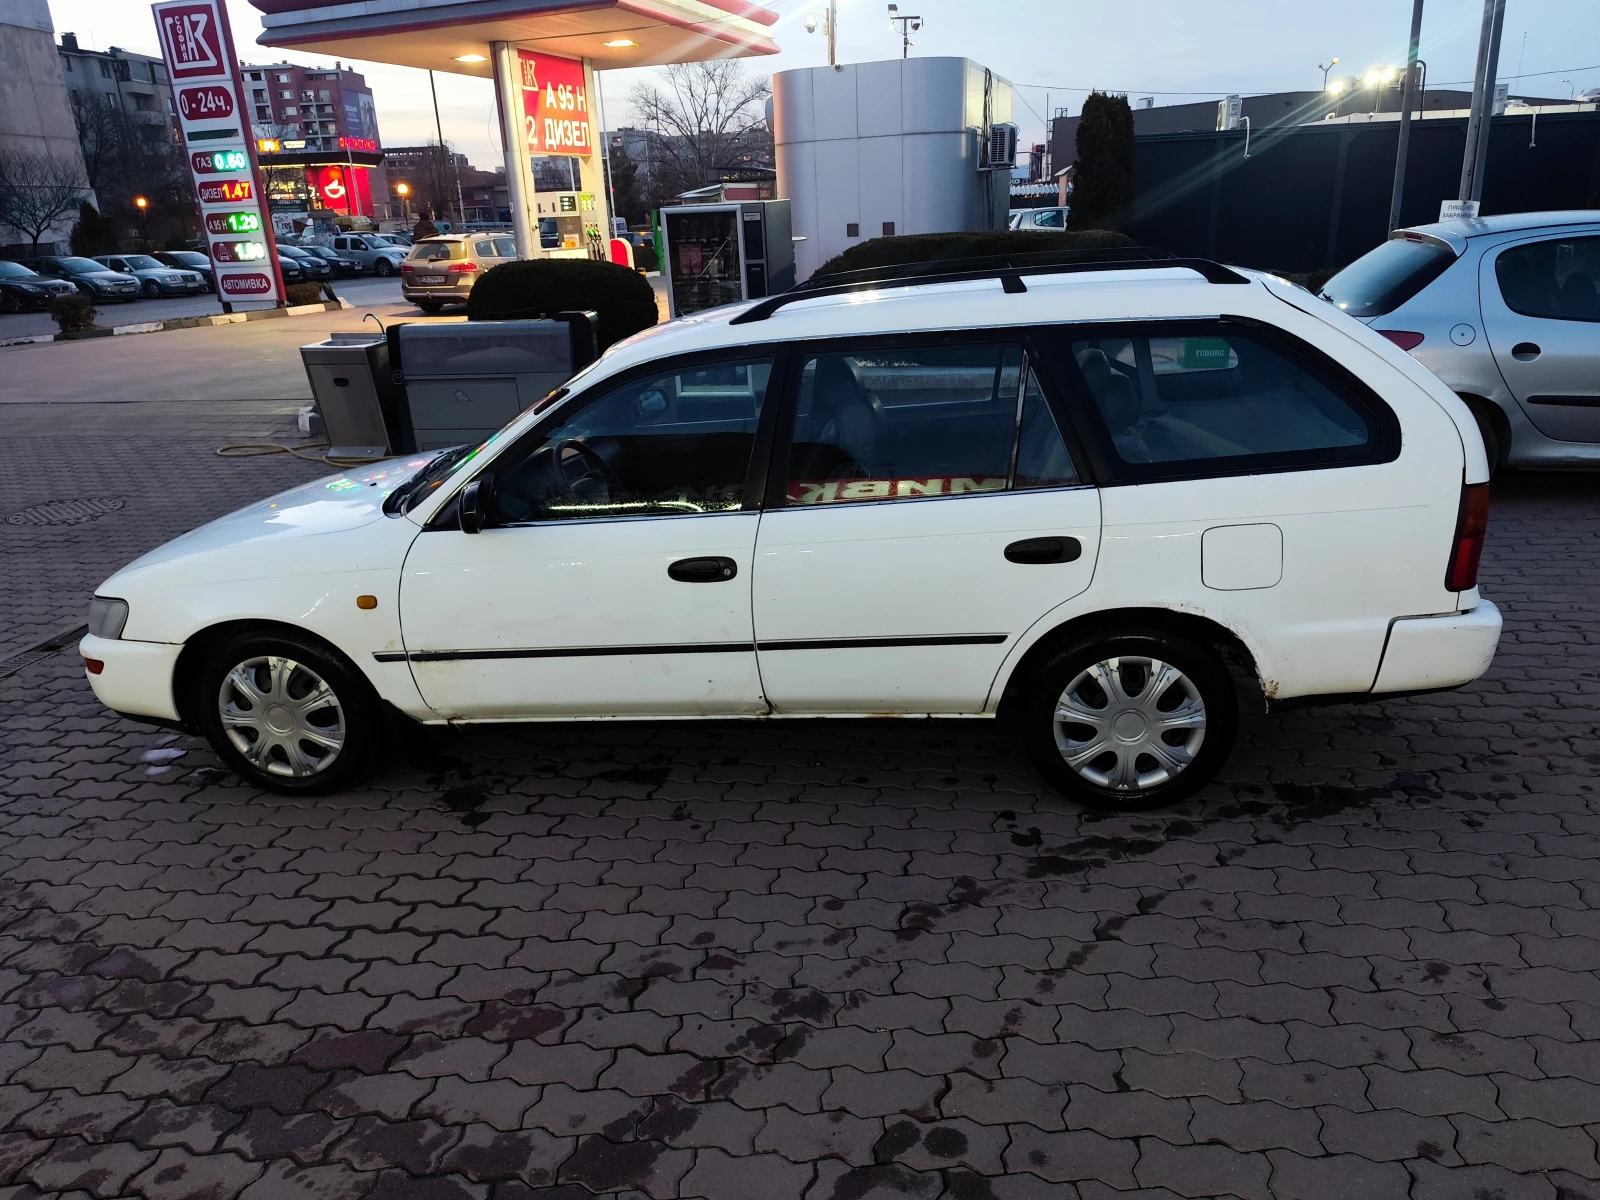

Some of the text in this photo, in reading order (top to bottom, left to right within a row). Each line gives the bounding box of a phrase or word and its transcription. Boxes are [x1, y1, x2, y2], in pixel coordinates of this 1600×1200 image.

[174, 15, 189, 61] СОФИЯ
[546, 81, 587, 112] А 95 Н
[526, 115, 590, 150] 2 ДИЗЕЛ
[195, 157, 212, 168] ГАЗ
[201, 182, 250, 200] ДИЗЕЛ 1.47
[214, 221, 222, 231] 95
[223, 278, 269, 290] АВТОМИВКА
[1195, 349, 1225, 357] TUBORG
